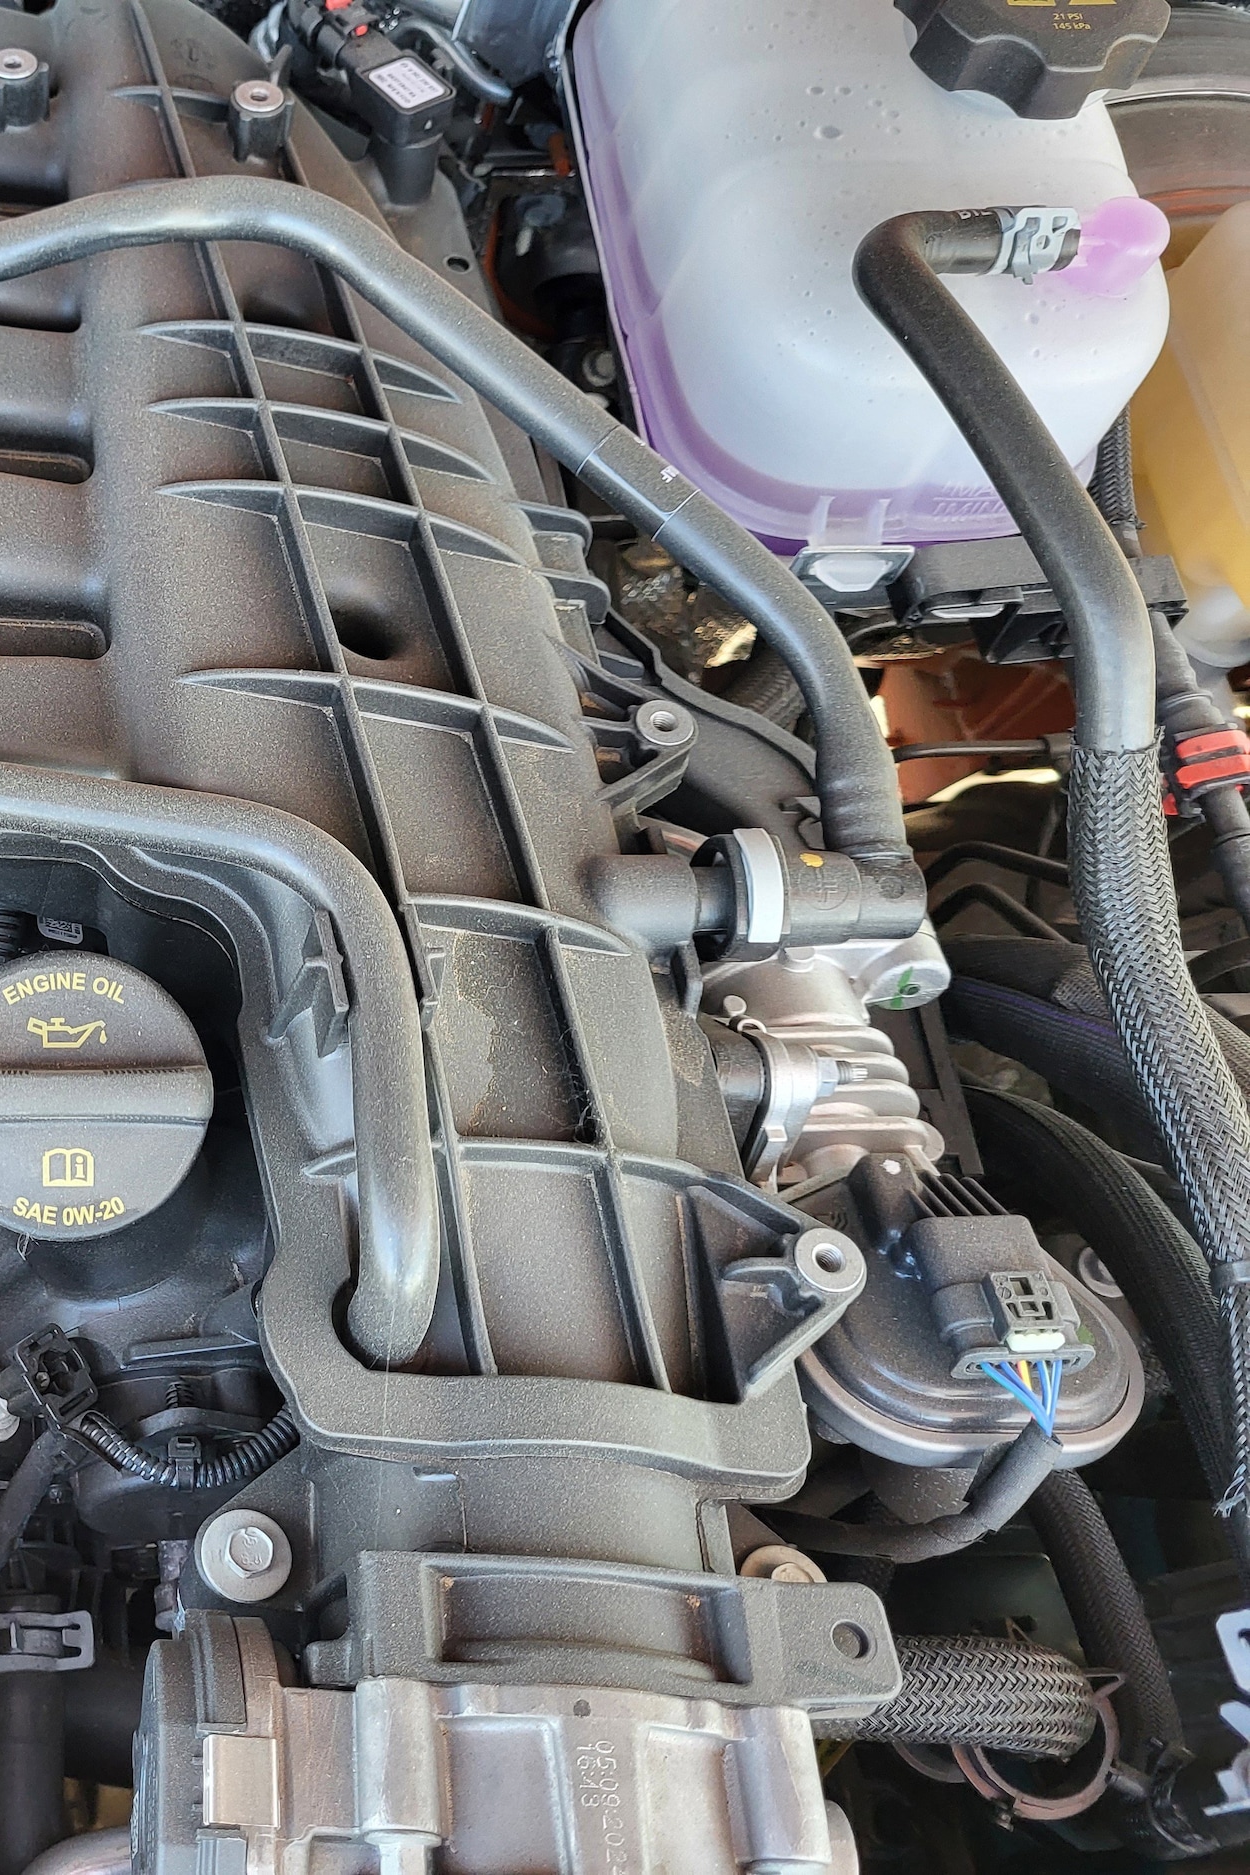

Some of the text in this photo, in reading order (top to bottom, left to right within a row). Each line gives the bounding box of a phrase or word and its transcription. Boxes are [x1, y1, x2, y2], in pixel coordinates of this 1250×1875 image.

[1053, 22, 1091, 30] 145 kPa
[2, 972, 125, 1005] ENGINE OIL
[12, 1196, 125, 1227] SAE 0W-20
